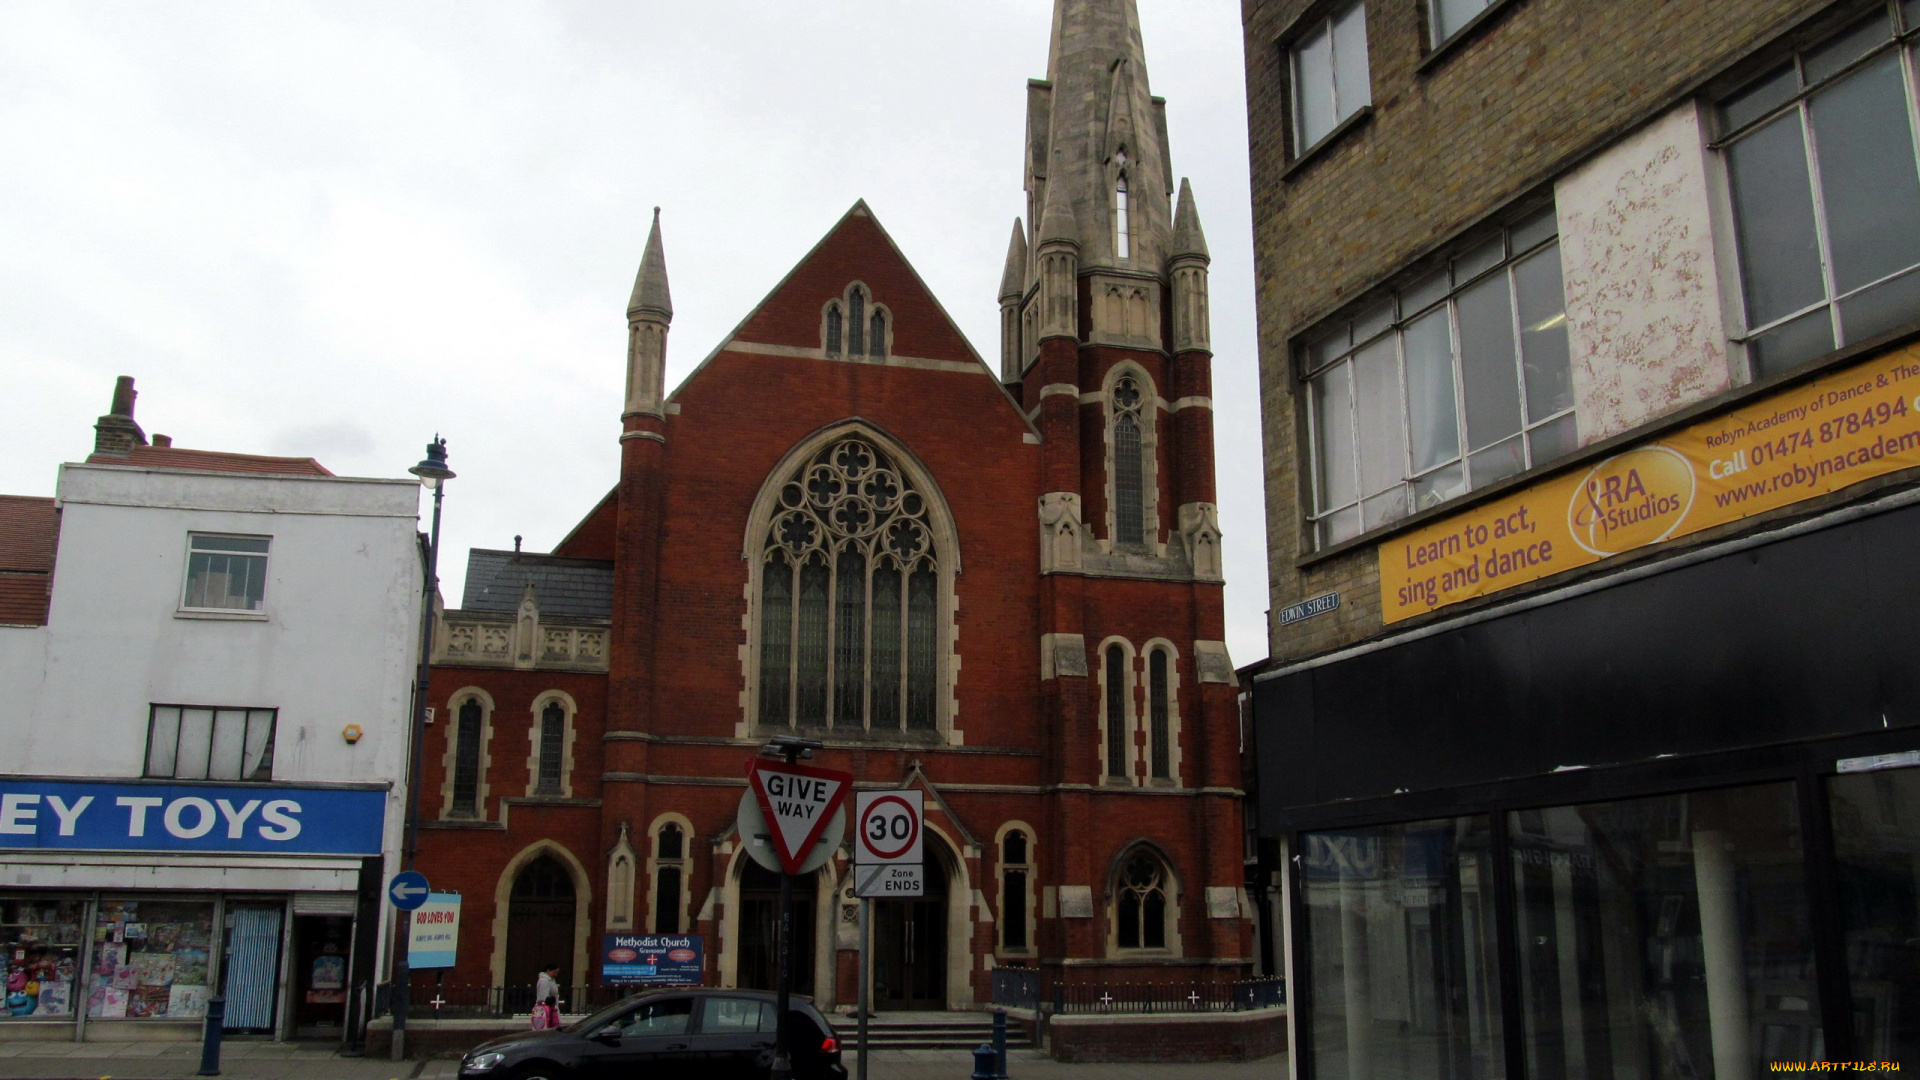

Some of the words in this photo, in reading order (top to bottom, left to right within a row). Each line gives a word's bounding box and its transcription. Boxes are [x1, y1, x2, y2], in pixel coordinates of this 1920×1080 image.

[1706, 427, 1745, 449] Robyn
[1748, 405, 1807, 435] Academy
[1811, 395, 1825, 412] of
[1828, 381, 1873, 406] Dance
[1876, 373, 1889, 388] &
[1709, 449, 1749, 480] Call
[1751, 428, 1814, 466] 01474
[1819, 395, 1908, 444] 878494
[1605, 468, 1647, 507] RA
[1608, 492, 1680, 531] Studios
[1406, 533, 1461, 570] Learn
[1464, 524, 1488, 549] to
[1494, 504, 1536, 539] act,
[1398, 576, 1438, 607] sing
[1442, 554, 1480, 593] and
[1485, 540, 1553, 578] dance
[1281, 604, 1304, 623] EDWIN
[1307, 594, 1336, 614] STREET
[767, 775, 827, 803] GIVE
[0, 794, 95, 837] EY
[116, 796, 303, 841] TOYS
[778, 801, 815, 819] WAY
[869, 814, 910, 841] 30
[885, 880, 920, 891] ENDS
[891, 869, 914, 878] Zone
[416, 911, 427, 924] GOD
[427, 911, 443, 924] LOVES
[444, 911, 455, 924] YOU
[615, 936, 658, 948] Methodist
[660, 936, 690, 948] Church
